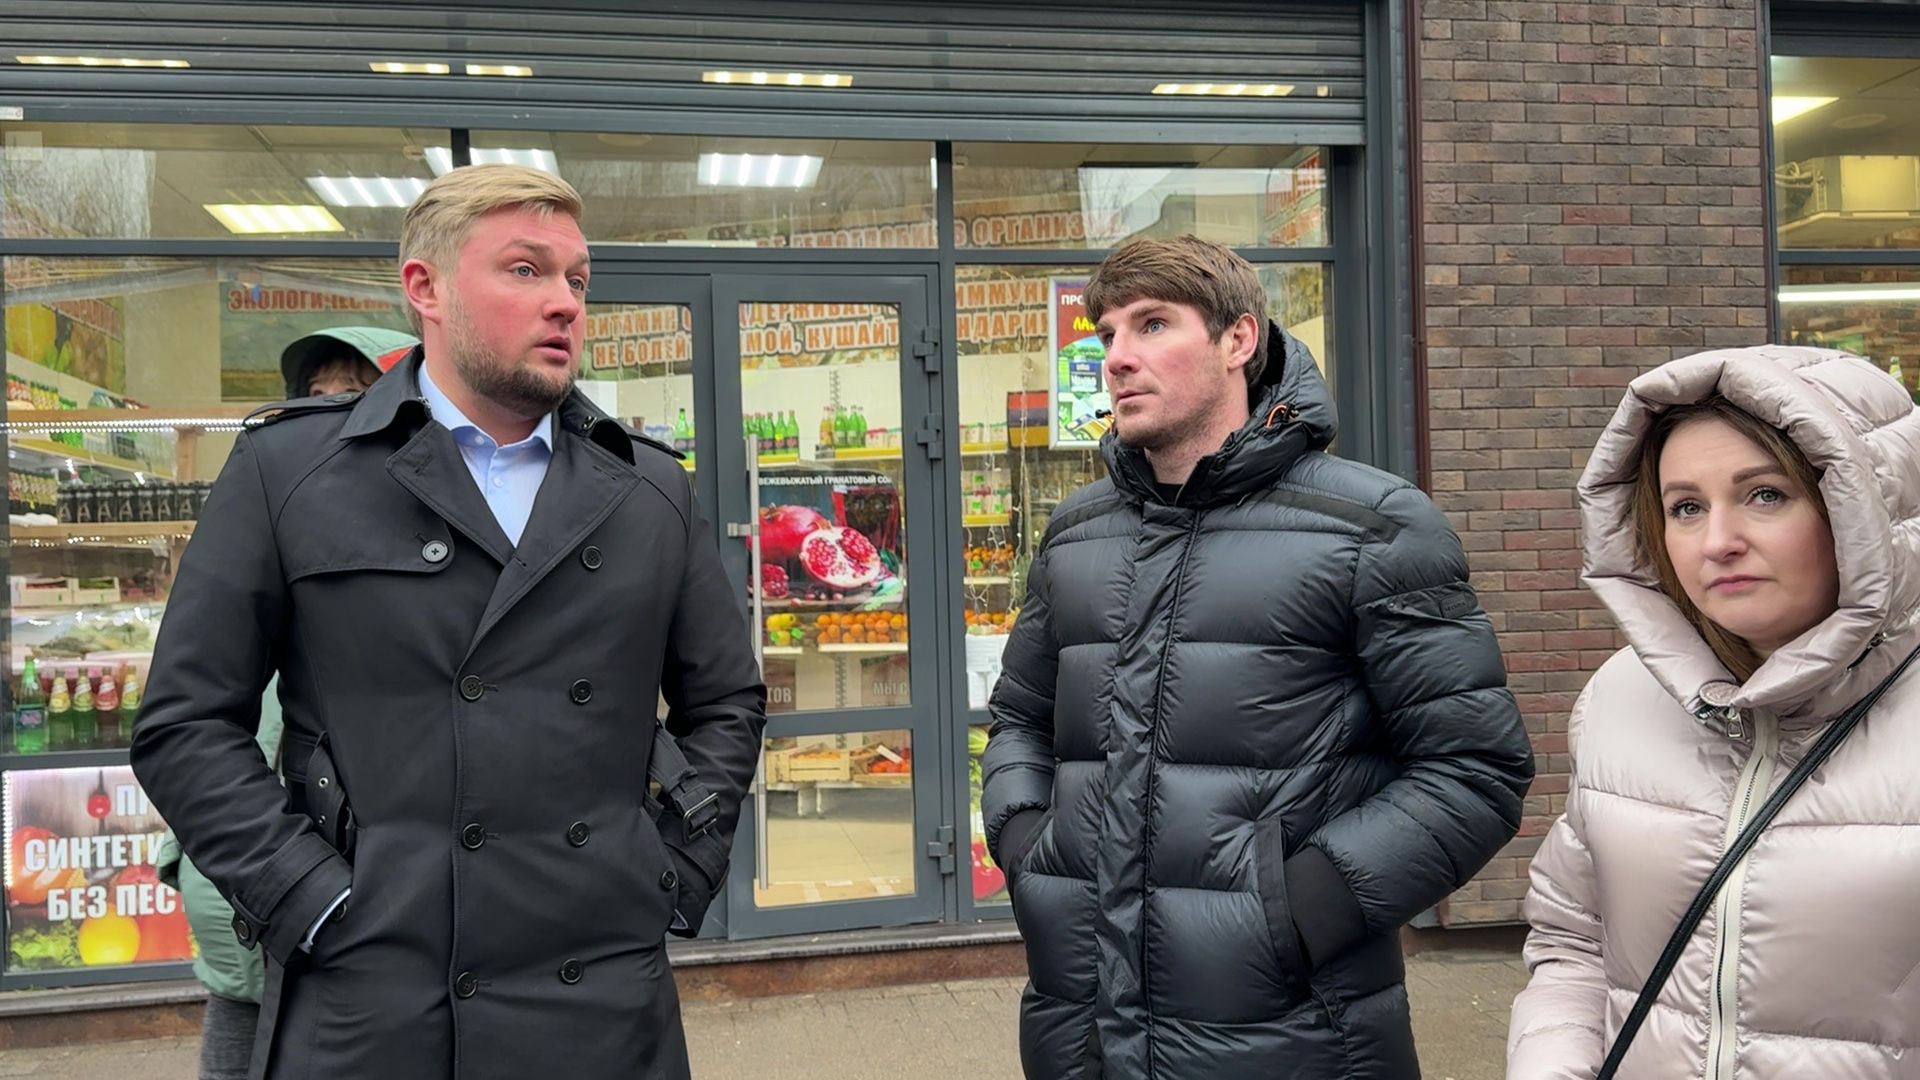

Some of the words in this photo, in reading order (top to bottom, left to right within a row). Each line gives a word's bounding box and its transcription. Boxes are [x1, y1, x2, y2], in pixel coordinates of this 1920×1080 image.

[594, 342, 618, 369] НЕ
[805, 316, 900, 350] КУШАЙТ
[759, 475, 823, 486] ВЕЖЕВЫЖАТЫЙ
[824, 475, 877, 485] ГРАНАТОВЫЙ
[24, 833, 164, 871] СИНТЕТИ
[48, 885, 107, 921] БЕЗ
[116, 882, 185, 917] ПЕС
